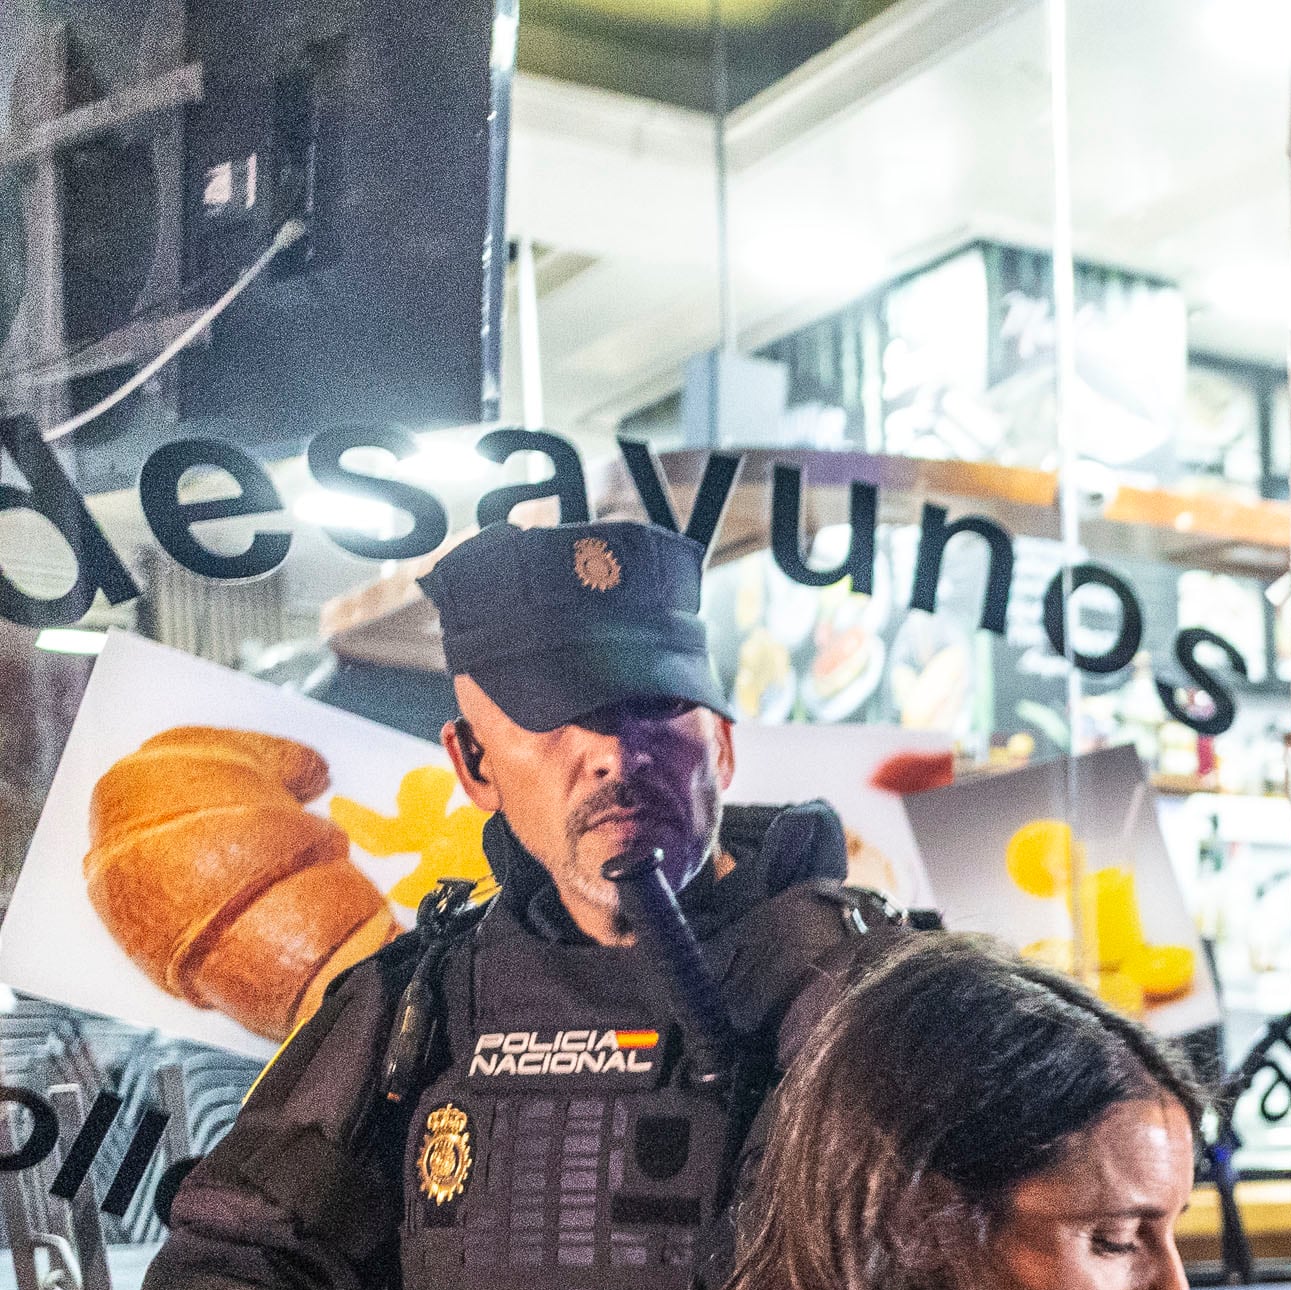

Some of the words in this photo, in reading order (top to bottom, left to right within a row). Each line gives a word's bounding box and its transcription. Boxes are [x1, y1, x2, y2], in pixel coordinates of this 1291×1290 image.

[0, 412, 1248, 735] desayunos
[474, 1029, 619, 1055] POLICIA
[467, 1049, 654, 1077] NACIONAL
